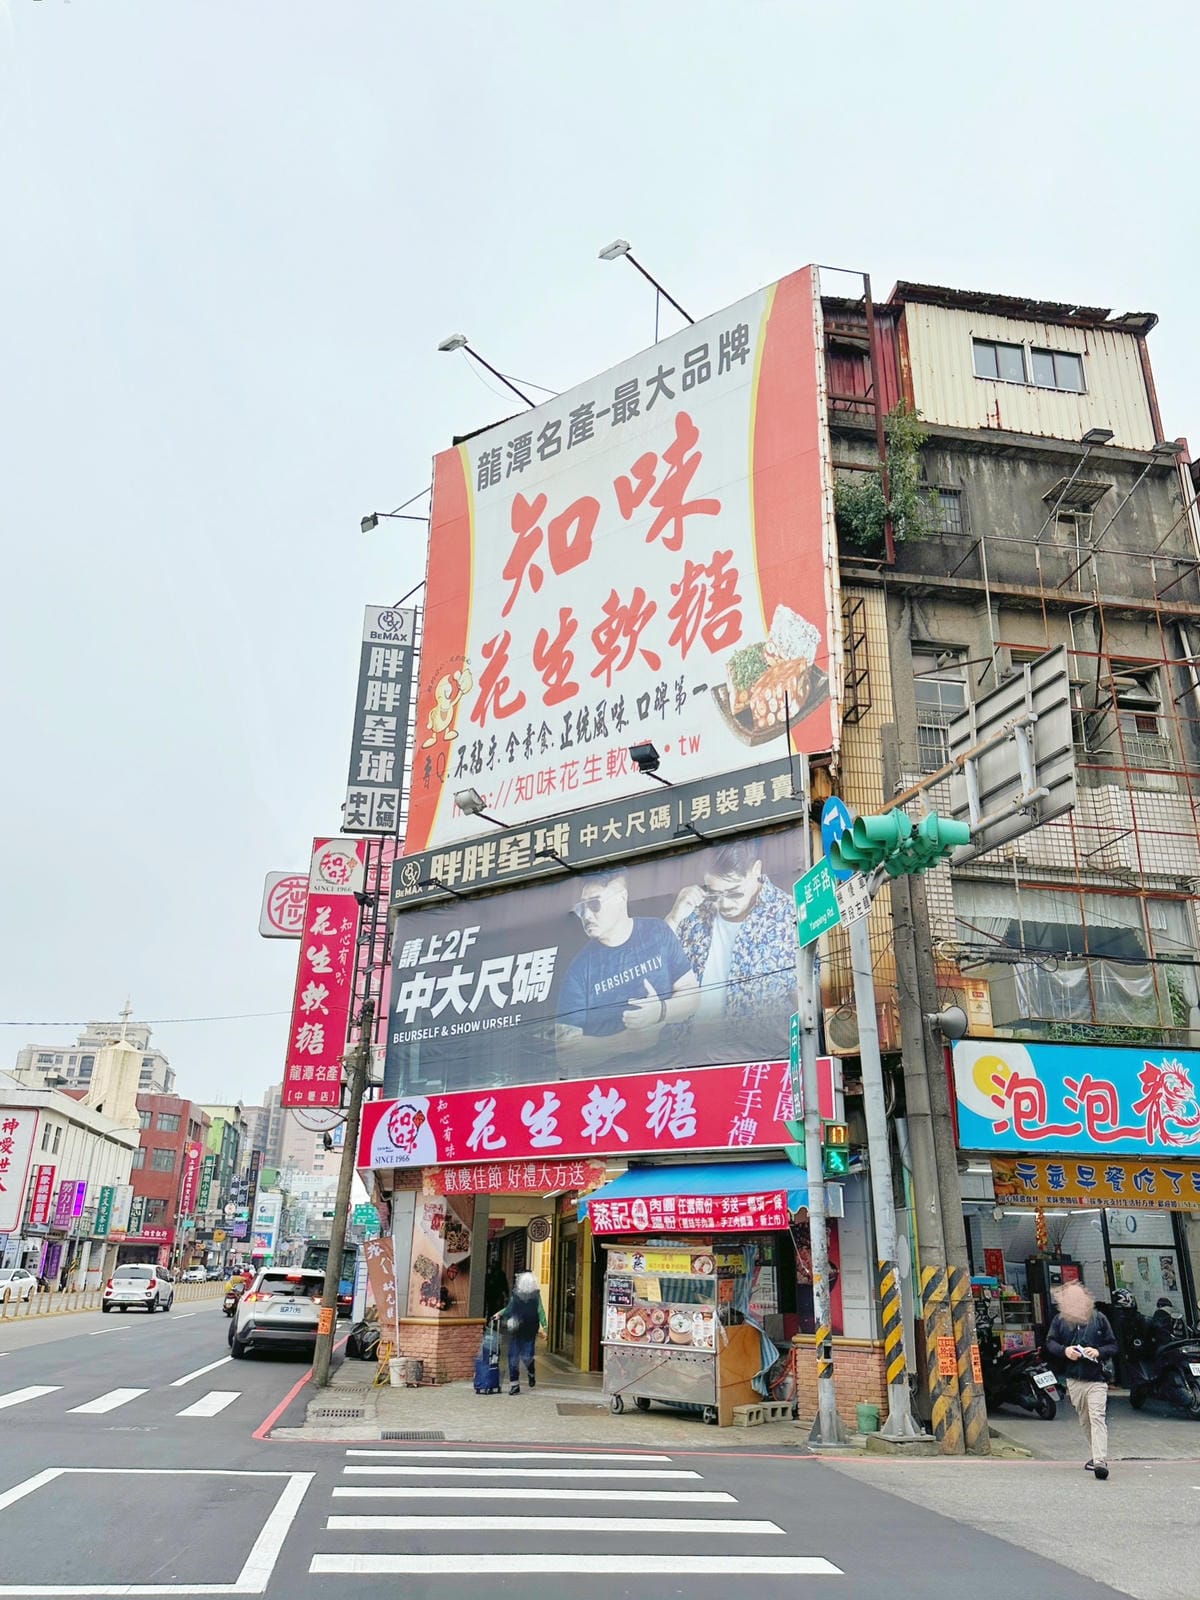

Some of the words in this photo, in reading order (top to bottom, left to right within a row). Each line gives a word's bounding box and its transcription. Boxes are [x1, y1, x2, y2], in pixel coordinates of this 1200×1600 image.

[502, 411, 721, 617] 知味
[470, 549, 742, 729] 花生軟糖
[357, 647, 404, 783] 胖胖星球
[428, 823, 570, 891] 胖胖星球
[580, 804, 671, 847] 中大尺碼
[296, 906, 337, 1055] 花生軟糖
[398, 925, 480, 970] 請上2F
[594, 955, 663, 996] PERSISTENTLY
[394, 945, 558, 1025] 中大尺碼
[393, 1028, 441, 1044] BEURSELF
[441, 1026, 450, 1037] &
[450, 1021, 480, 1035] SHOW
[482, 1014, 522, 1030] URSELF
[289, 1064, 338, 1081] 龍潭名產
[728, 1064, 770, 1146] 伴手禮
[437, 1099, 455, 1158] 知心有味
[465, 1078, 698, 1152] 花生軟糖
[375, 1156, 395, 1164] SINCE
[396, 1155, 410, 1163] 1966
[444, 1165, 502, 1192] 歡慶佳節
[508, 1161, 585, 1189] 好禮大方送
[592, 1203, 631, 1231] 蒸記
